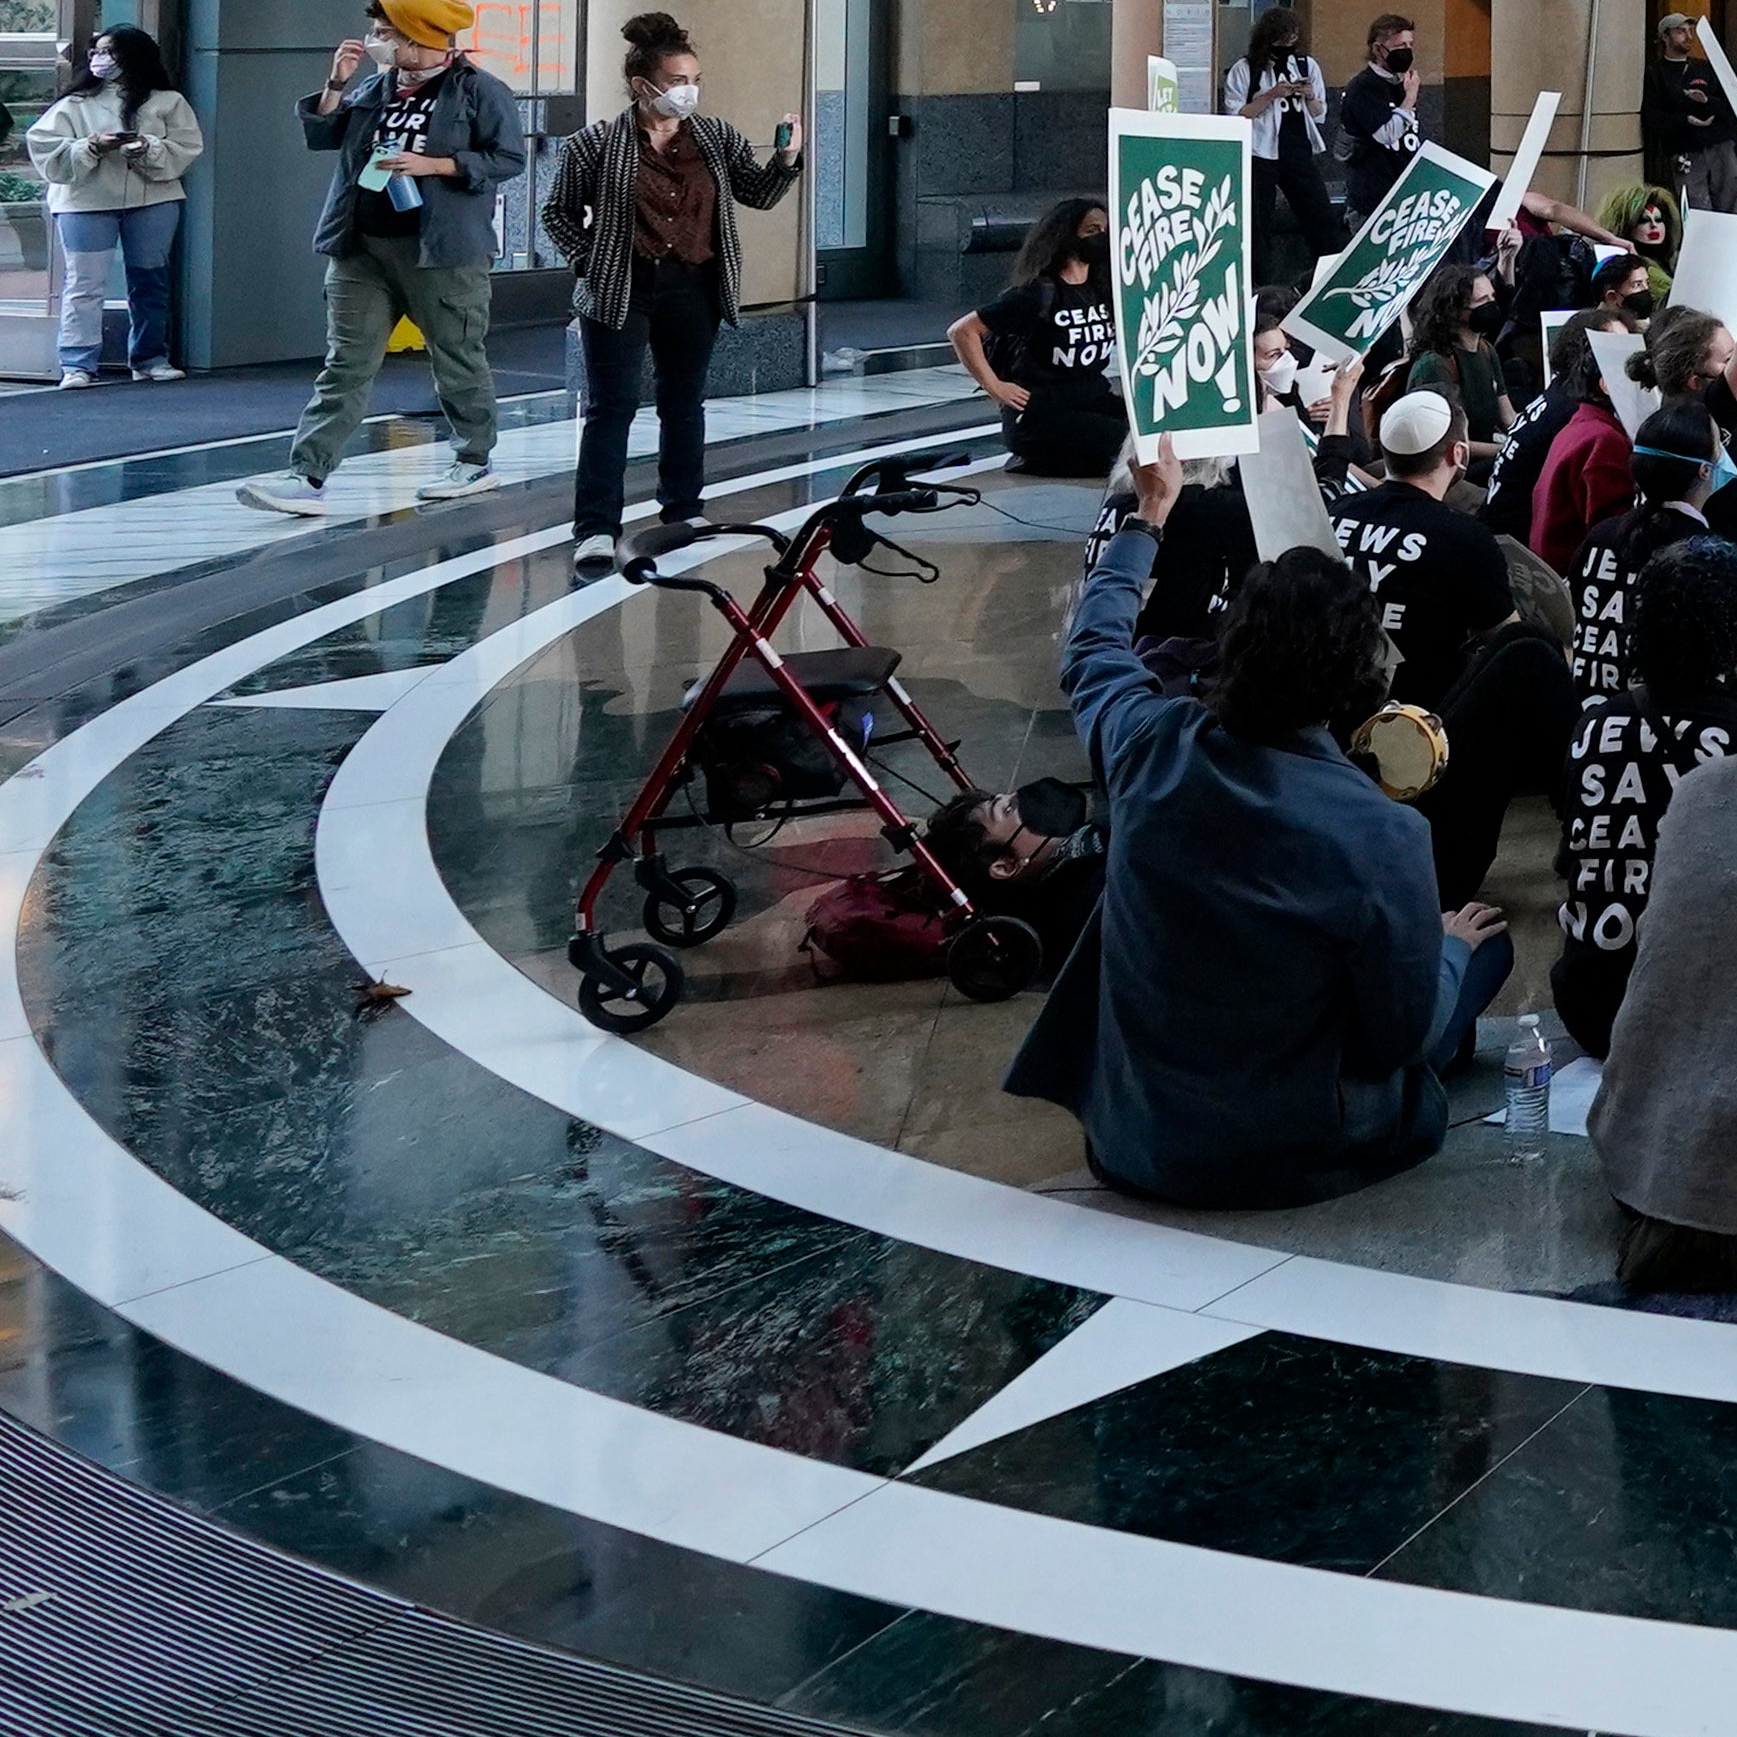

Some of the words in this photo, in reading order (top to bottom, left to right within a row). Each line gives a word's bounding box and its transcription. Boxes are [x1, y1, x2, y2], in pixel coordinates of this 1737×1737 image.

[1119, 164, 1205, 287] CEASE
[1370, 189, 1461, 245] CEASE
[1387, 219, 1440, 257] FIRE
[1138, 210, 1194, 292] FIRE
[1055, 302, 1110, 327] CEAS
[1153, 261, 1242, 423] NOW!
[1330, 516, 1428, 562] EWS
[1557, 901, 1638, 952] NO
